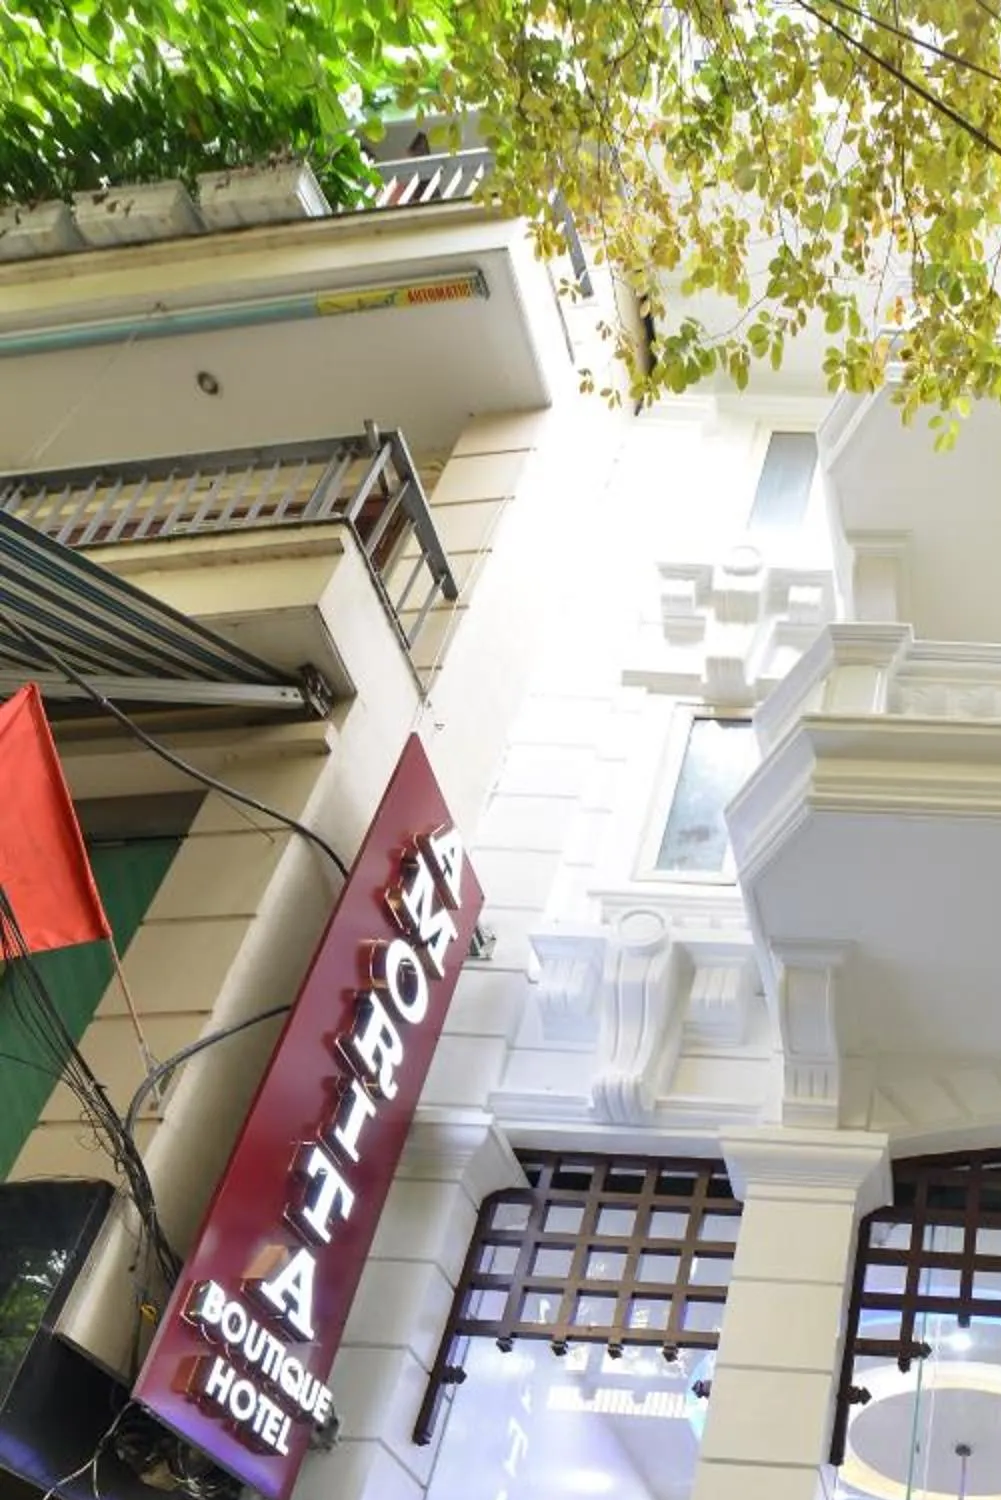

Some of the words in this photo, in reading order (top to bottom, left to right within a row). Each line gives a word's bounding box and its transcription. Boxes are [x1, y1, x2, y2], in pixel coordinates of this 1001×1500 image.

[261, 826, 464, 1342] AMORITA
[201, 1279, 333, 1423] BOUTIQUE
[205, 1356, 292, 1456] HOTEL
